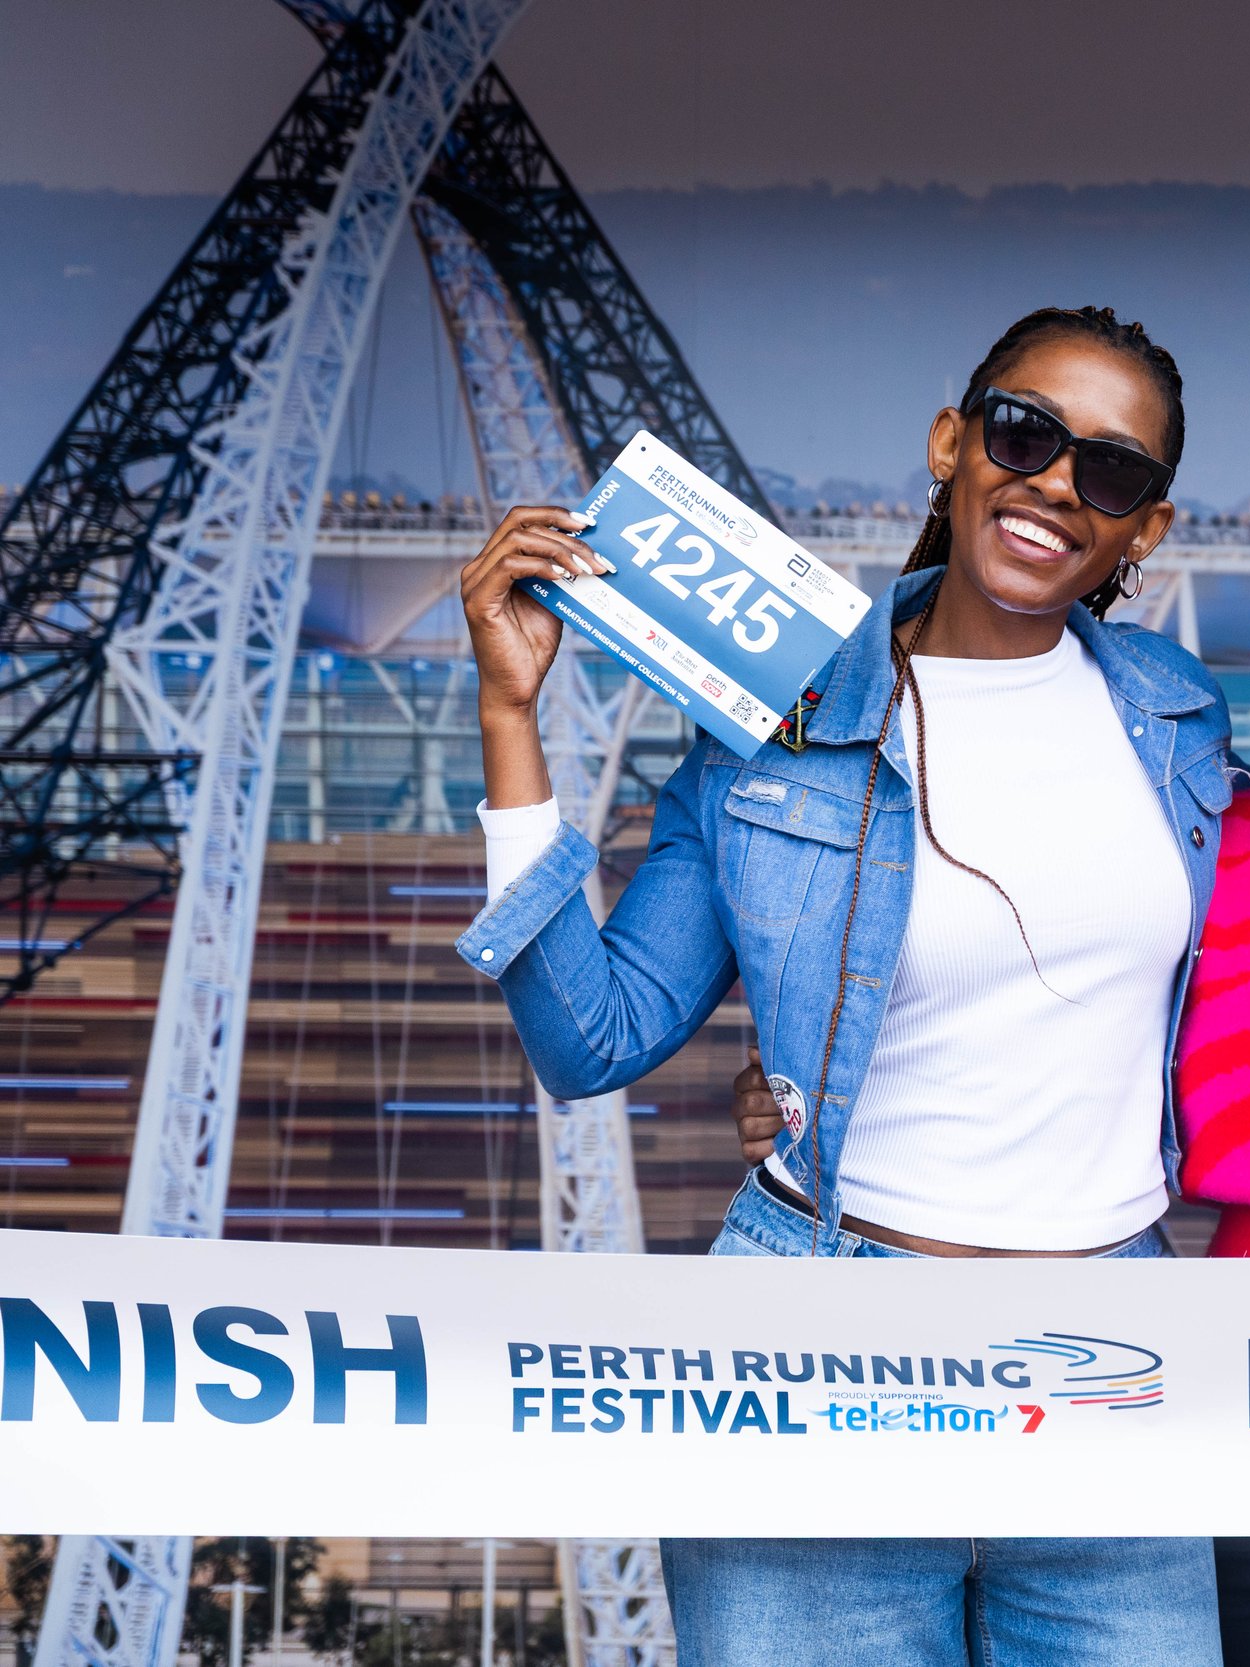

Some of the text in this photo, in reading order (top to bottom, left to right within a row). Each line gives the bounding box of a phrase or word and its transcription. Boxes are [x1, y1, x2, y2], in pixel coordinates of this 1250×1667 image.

[648, 473, 693, 512] FESTIVAL
[696, 510, 723, 534] telthon
[654, 465, 736, 529] PERTH RUNNING
[532, 583, 549, 598] 4245
[619, 512, 797, 654] 4245
[555, 601, 593, 632] MARATHON
[590, 626, 620, 654] FINISHER
[618, 648, 641, 667] SHIRT
[637, 663, 677, 696] COLLECTION
[675, 691, 690, 706] TAG
[702, 680, 720, 697] now
[705, 673, 727, 691] perth
[508, 1342, 1031, 1389] PERTH RUNNING
[512, 1387, 1046, 1434] FESTIVAL telethon 7
[828, 1391, 944, 1400] PROUDLY SUPPORTING
